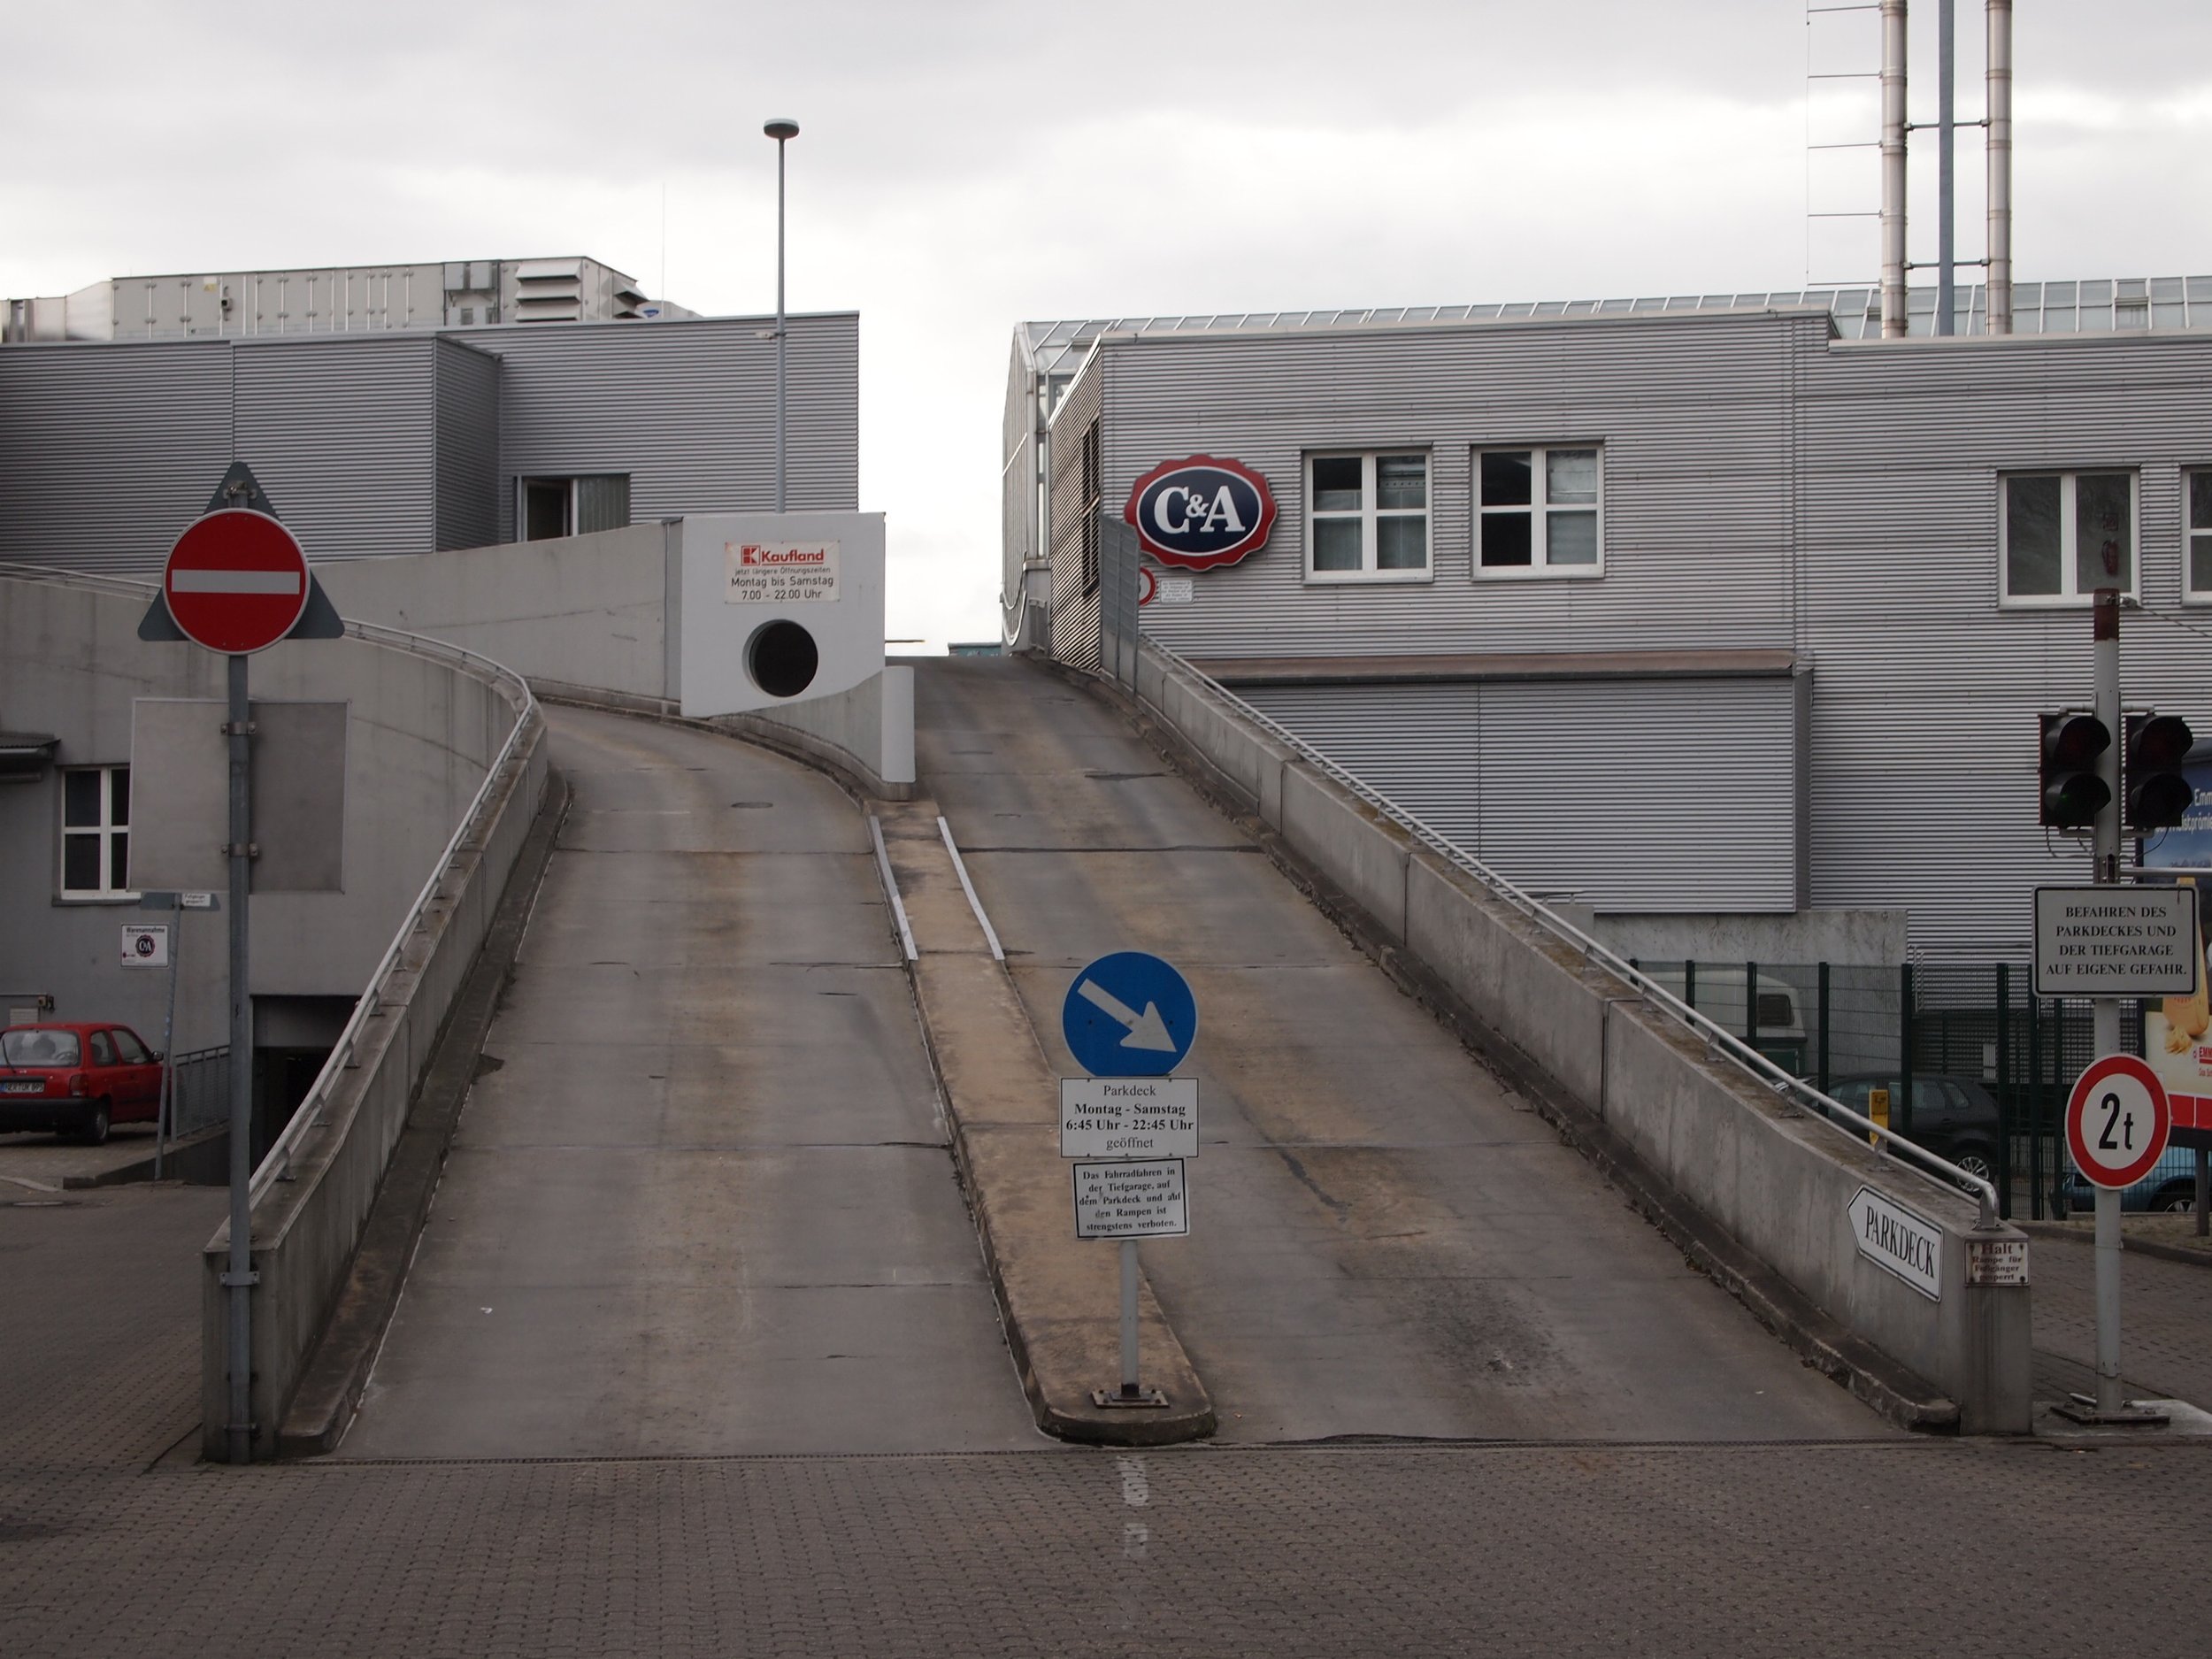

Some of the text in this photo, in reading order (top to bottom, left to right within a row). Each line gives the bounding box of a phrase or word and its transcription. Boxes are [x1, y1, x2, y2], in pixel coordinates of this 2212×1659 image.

[1154, 485, 1246, 534] C&A
[761, 549, 825, 563] Kaufland
[731, 576, 834, 588] Montag bis Samstag
[804, 589, 822, 599] Uhr
[2065, 906, 2167, 918] BEFAHREN DES
[2055, 926, 2177, 937] PARKDECKES UND
[2059, 944, 2174, 956] DER TIEFGARAGE
[2046, 964, 2187, 975] AUF EIGENE GEFAHR.
[1103, 1085, 1156, 1096] Parkdeck
[1074, 1104, 1123, 1117] Montag
[1133, 1103, 1186, 1117] Samstag
[1066, 1119, 1093, 1131] 6:45
[1096, 1119, 1121, 1131] Uhr
[1132, 1119, 1166, 1131] 22:45
[1170, 1119, 1194, 1131] Uhr
[1106, 1137, 1154, 1151] geöffnet
[1082, 1166, 1176, 1180] Das Fahrradfahren in
[1088, 1184, 1103, 1193] der
[1156, 1180, 1171, 1189] auf
[1079, 1192, 1182, 1206] dem Parkdeck und auf
[1116, 1207, 1152, 1219] Rampen
[1156, 1205, 1167, 1216] ist
[1086, 1219, 1178, 1233] strengstens verboten.
[1865, 1205, 1936, 1279] PARKDECK
[1981, 1243, 2013, 1255] Halt
